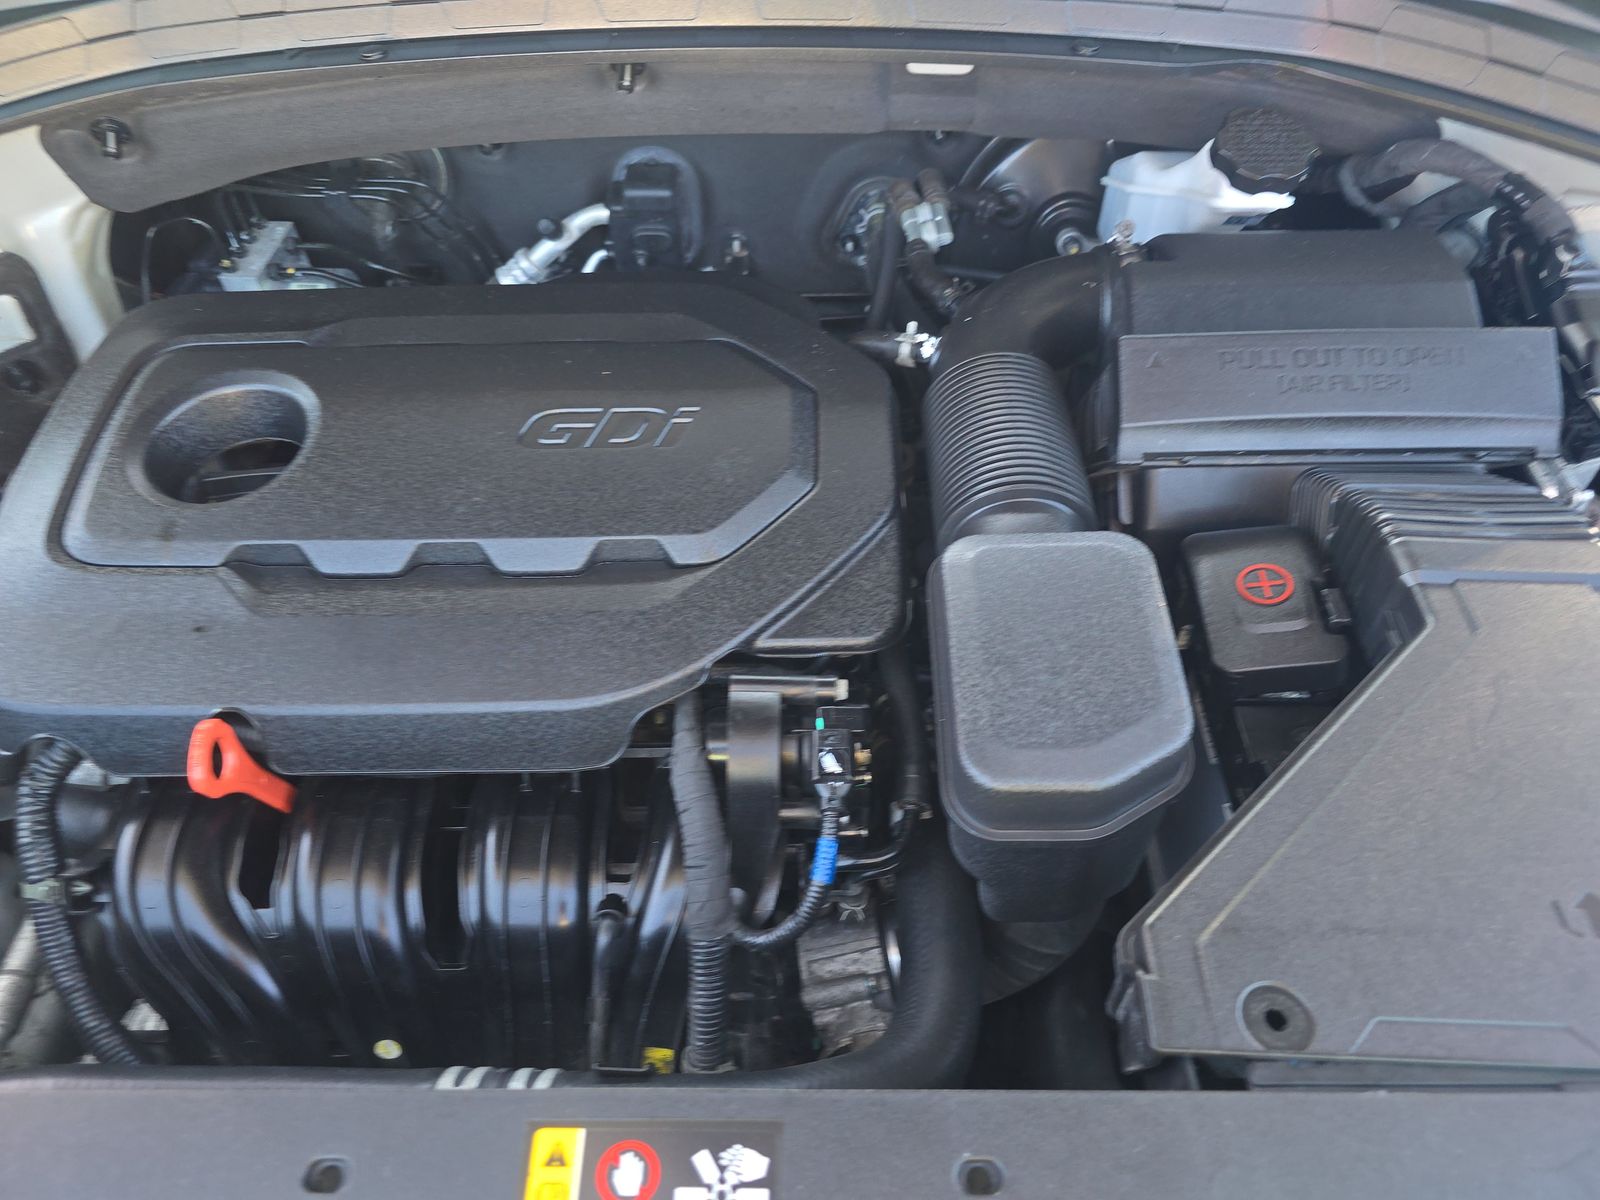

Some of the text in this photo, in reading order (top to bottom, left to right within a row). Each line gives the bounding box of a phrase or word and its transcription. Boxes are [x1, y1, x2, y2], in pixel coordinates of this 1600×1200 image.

[1217, 345, 1466, 371] PULL OUT TO OPEN
